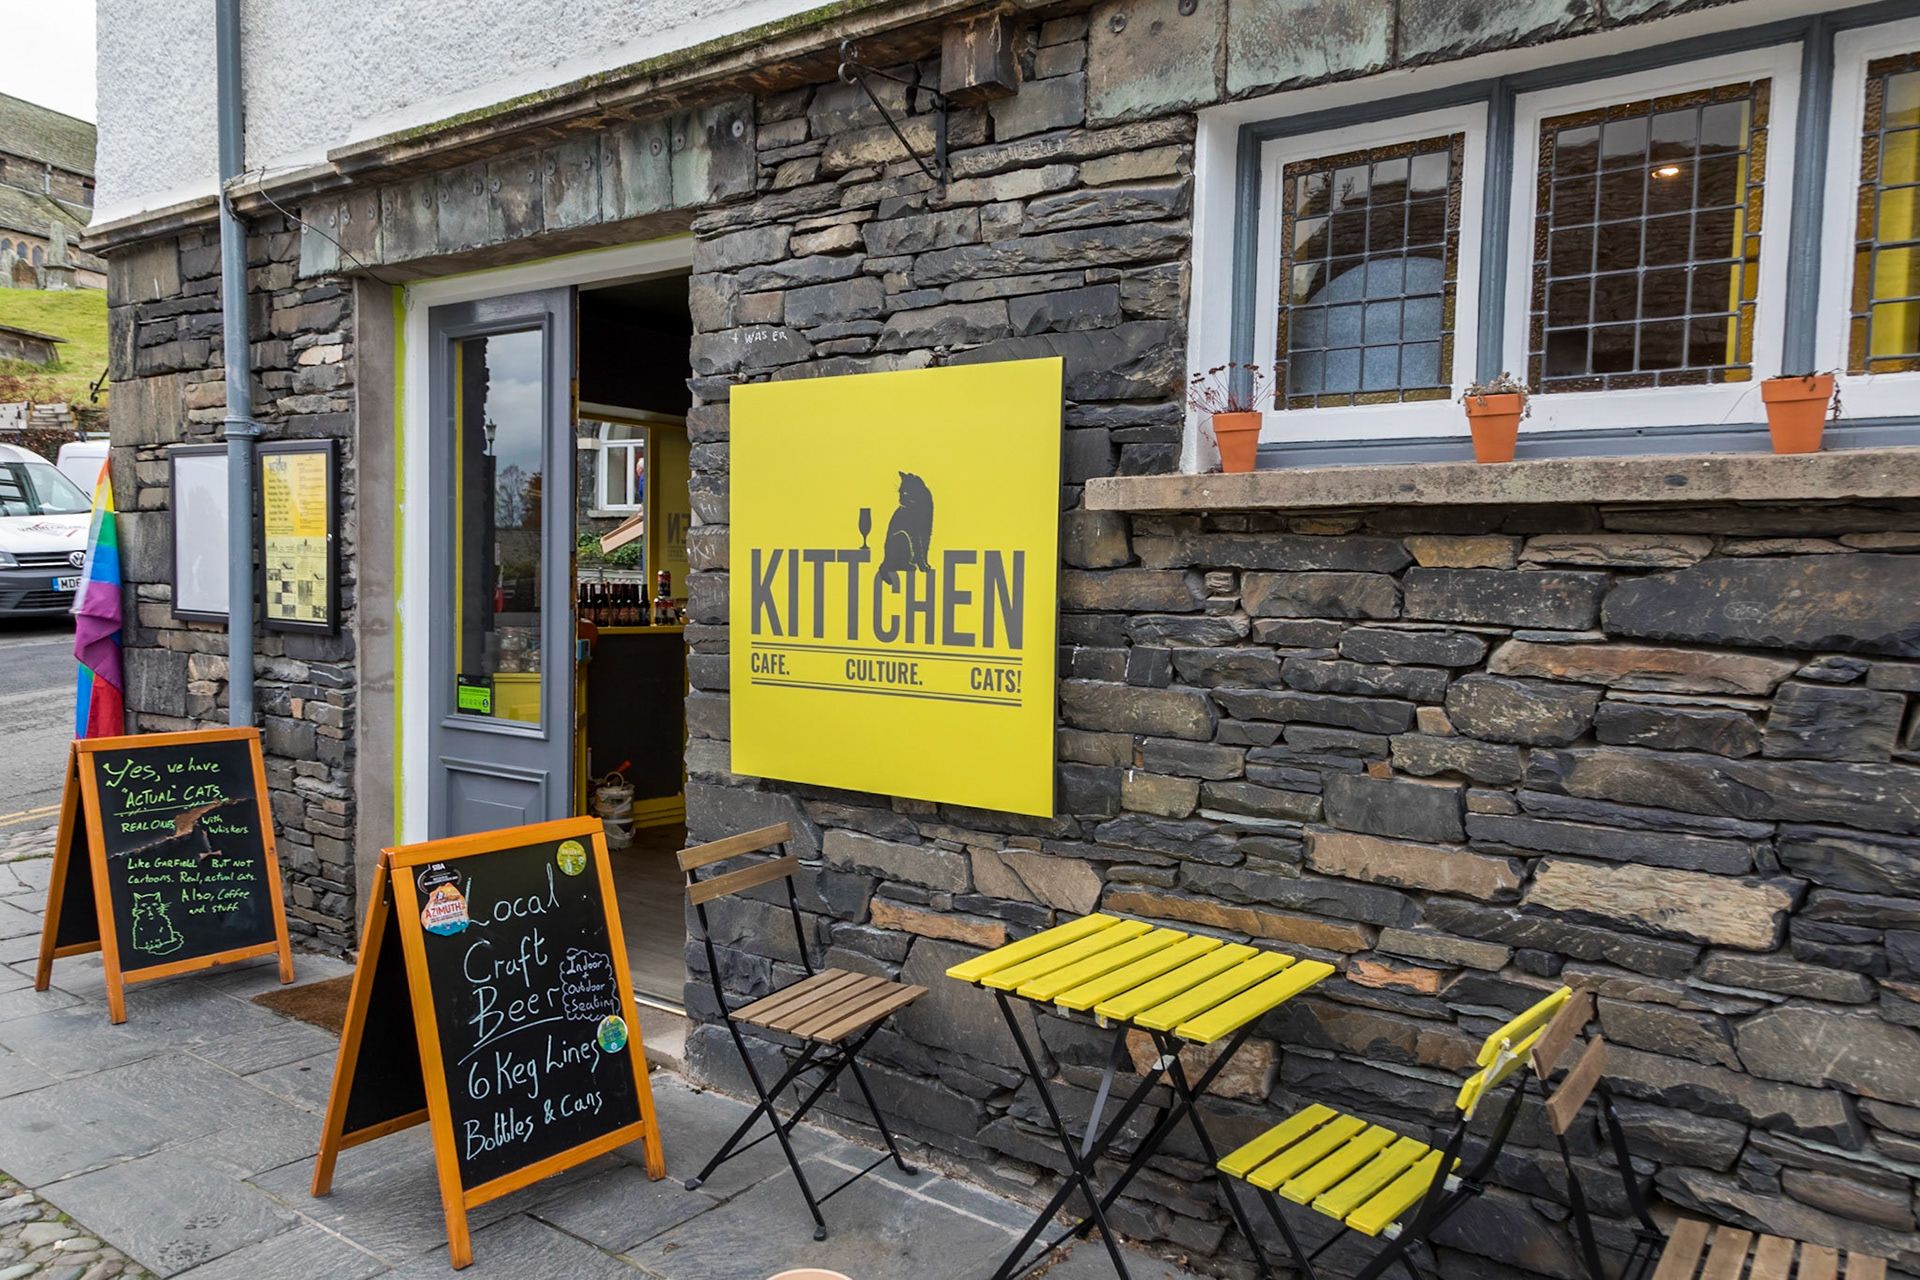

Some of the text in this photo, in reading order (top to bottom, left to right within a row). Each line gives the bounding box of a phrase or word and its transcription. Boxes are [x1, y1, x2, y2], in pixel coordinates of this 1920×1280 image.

[60, 577, 82, 589] MD6
[751, 548, 1025, 650] KITTCHEN
[751, 652, 1022, 694] CAFE. CULTURE. CATS!
[102, 757, 221, 787] Yes, we have
[183, 784, 223, 801] CATS.
[121, 821, 150, 833] REAL
[127, 857, 151, 870] Like
[204, 871, 234, 882] actual
[188, 904, 206, 915] and
[462, 862, 560, 933] Local
[425, 902, 461, 919] AZIMUTH
[463, 927, 548, 987] Craft
[566, 955, 603, 975] Indoor
[468, 985, 560, 1048] Beer
[468, 1034, 600, 1100] 6 Keg Lines
[463, 1091, 604, 1161] Bottles & Cans
